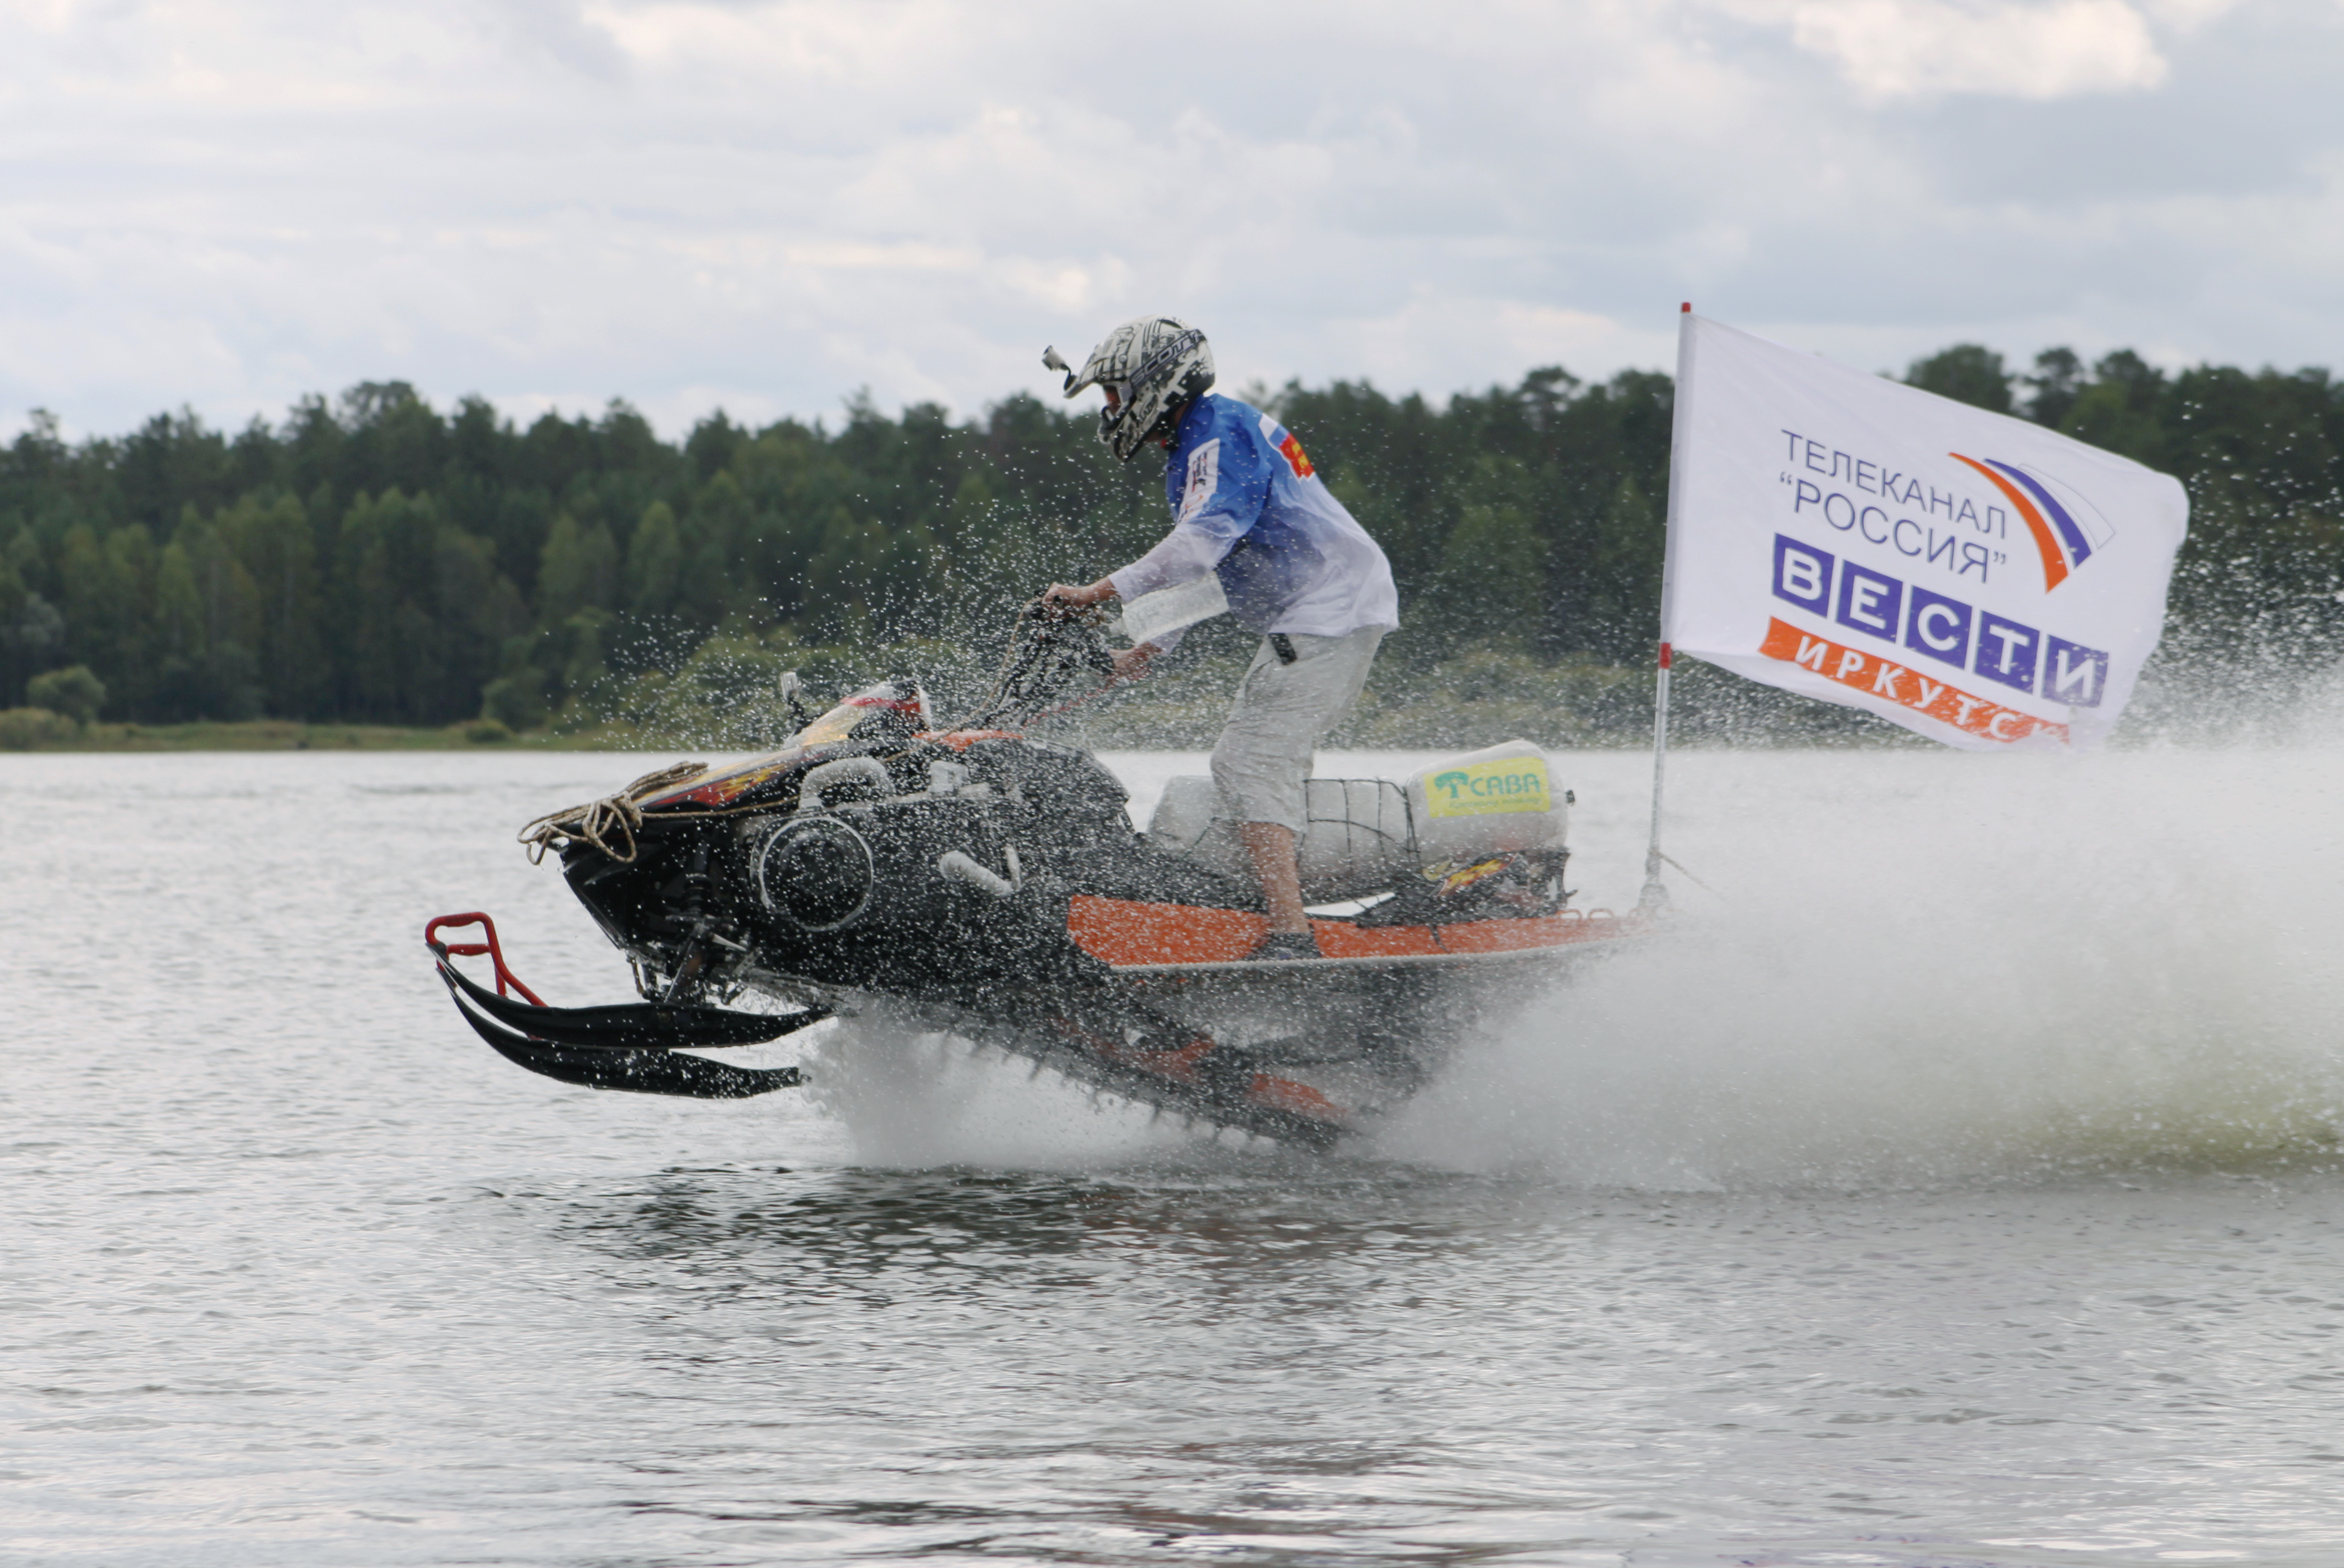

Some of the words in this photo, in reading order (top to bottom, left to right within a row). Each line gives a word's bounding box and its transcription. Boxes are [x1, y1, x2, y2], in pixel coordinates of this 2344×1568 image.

[1779, 471, 2007, 583] “РОССИЯ”
[1781, 429, 2006, 539] ТЕЛЕКАНАЛ
[1782, 547, 2095, 698] ВЕСТИ
